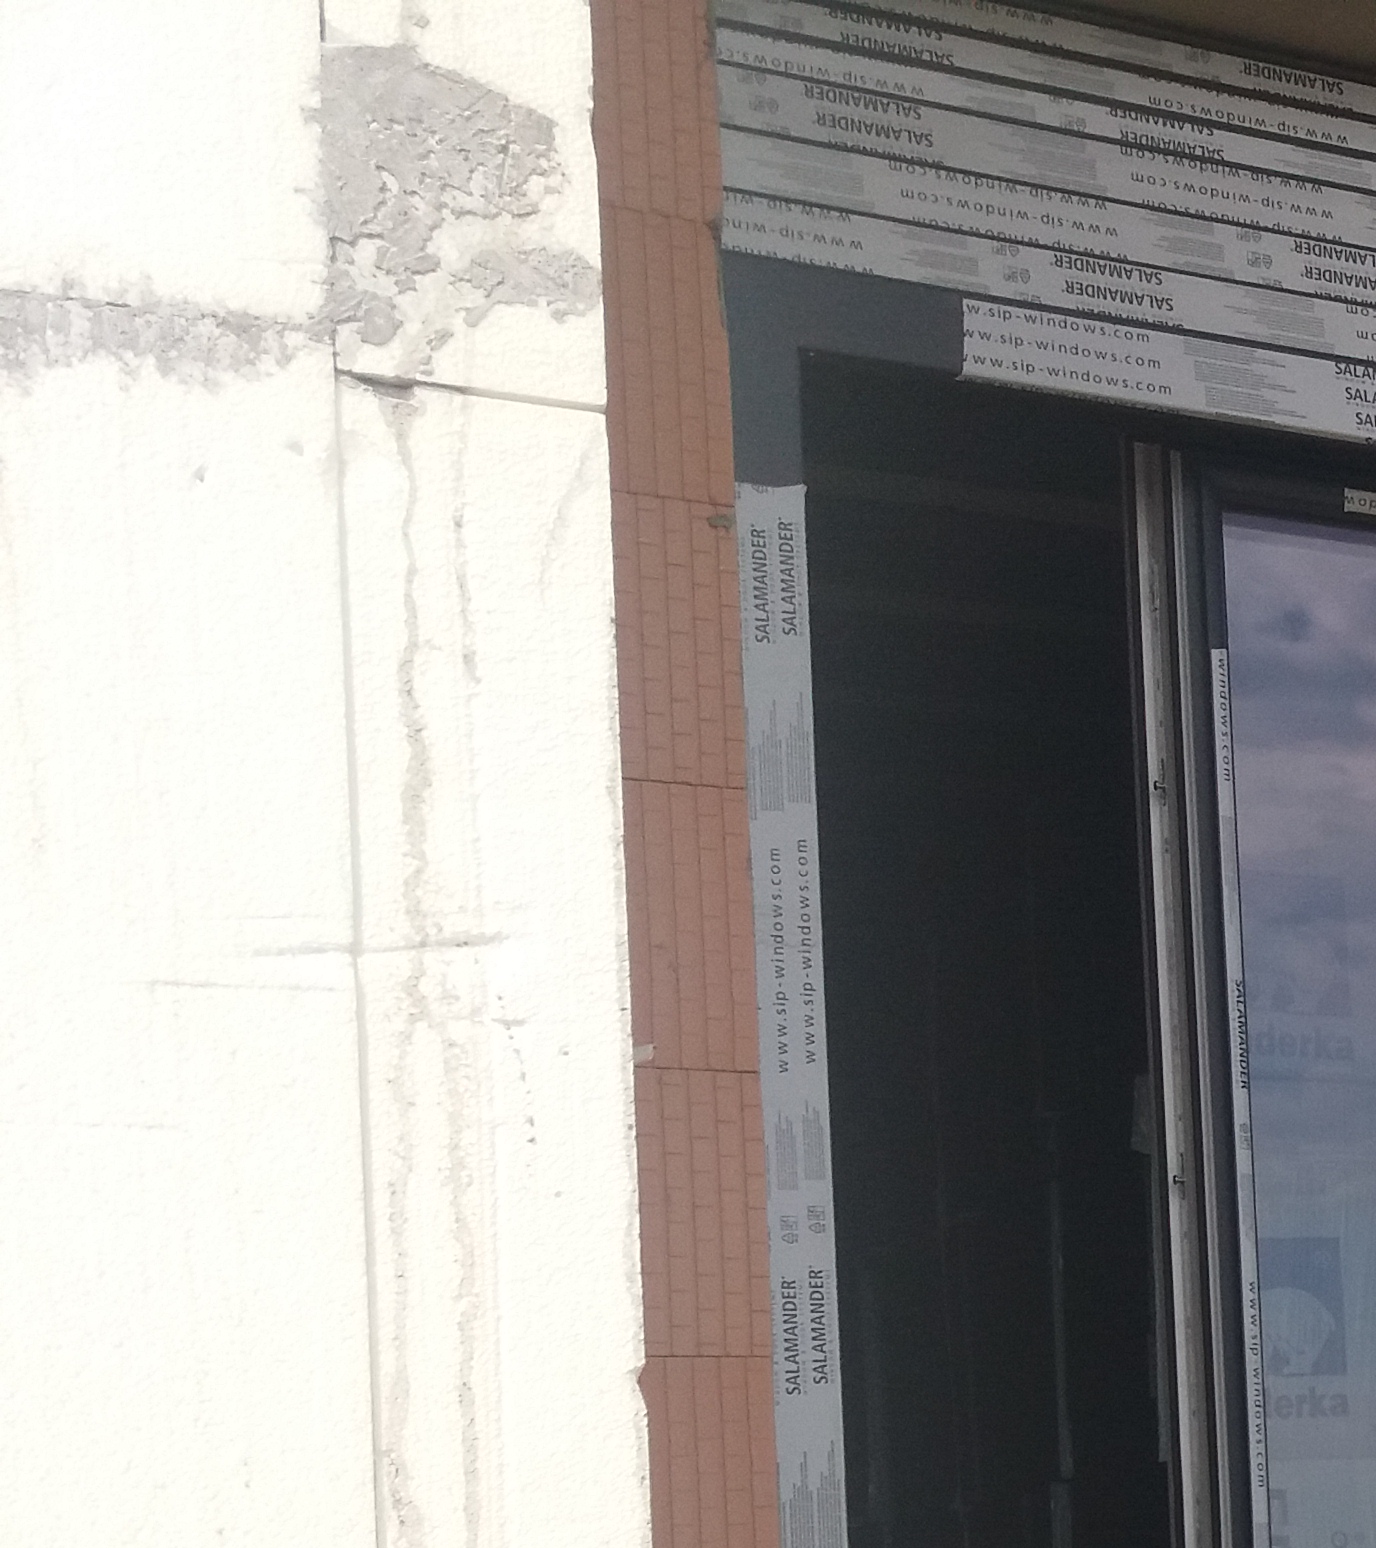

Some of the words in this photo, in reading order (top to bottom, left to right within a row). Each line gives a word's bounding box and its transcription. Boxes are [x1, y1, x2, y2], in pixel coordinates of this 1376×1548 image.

[803, 83, 922, 120] SALAMANDER
[1239, 61, 1344, 96] SALAMANDER
[815, 111, 933, 147] SALAMANDER
[1148, 95, 1348, 145] www.sip-windows.com
[900, 188, 1118, 238] www.sip-windows.com
[1130, 170, 1334, 220] www.sip-windows.com
[1050, 253, 1162, 285] SALAMANDER
[1063, 280, 1173, 311] SALAMANDER
[963, 353, 1172, 396] ww.sip-windows.com
[750, 523, 771, 643] SALAMANDER
[777, 516, 798, 636] SALAMANDER
[771, 848, 790, 1074] www.sip-windows.com
[797, 838, 817, 1065] www.sip-windows.com
[781, 1277, 802, 1395] SALAMANDER
[808, 1265, 829, 1385] SALAMANDER
[1248, 1280, 1266, 1488] www.sip-windows.com
